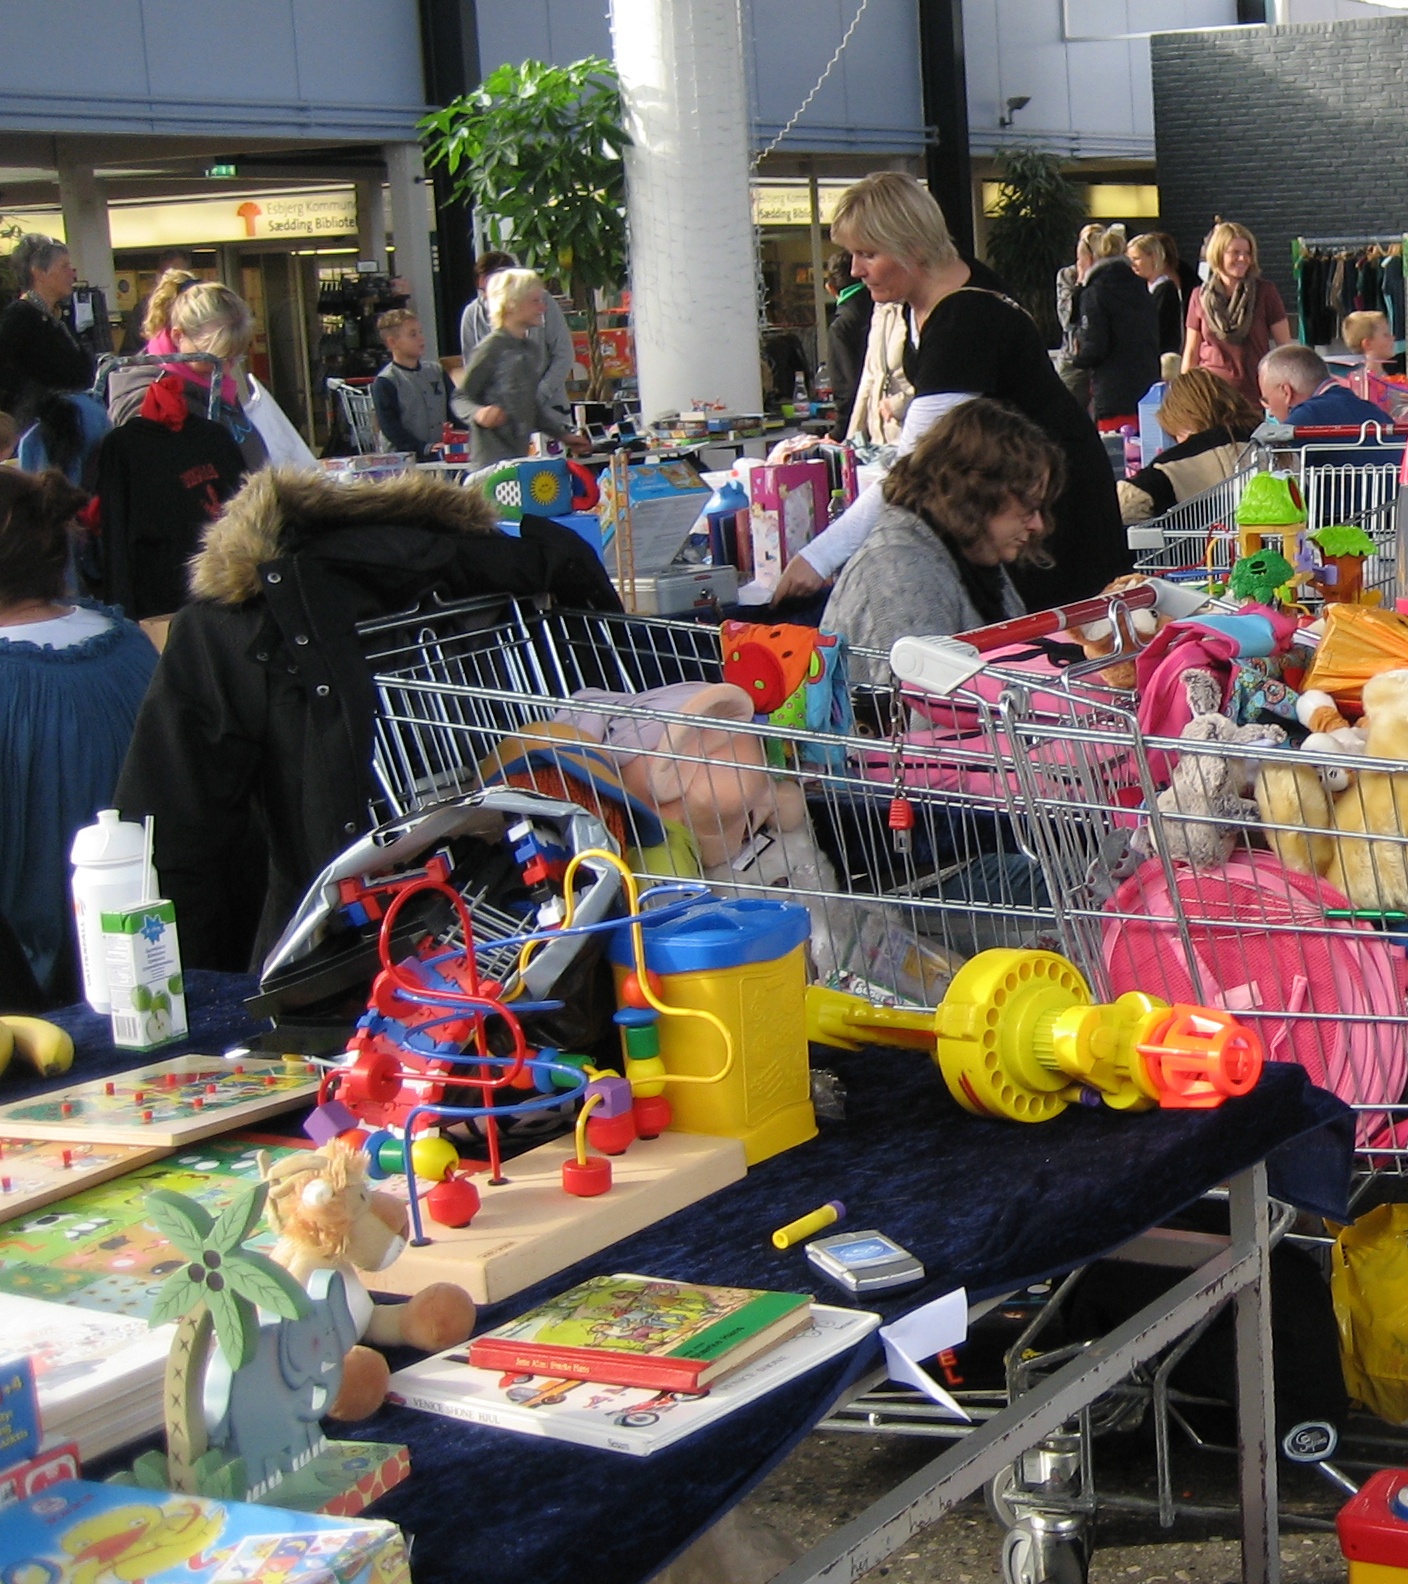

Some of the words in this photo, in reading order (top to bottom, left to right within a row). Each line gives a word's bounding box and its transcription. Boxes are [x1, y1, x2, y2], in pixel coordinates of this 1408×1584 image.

[267, 202, 304, 217] Esbjerg
[268, 219, 313, 233] Sædding
[413, 1398, 445, 1414] VENICE
[446, 1404, 474, 1420] SHONE
[478, 1411, 500, 1425] HJUL
